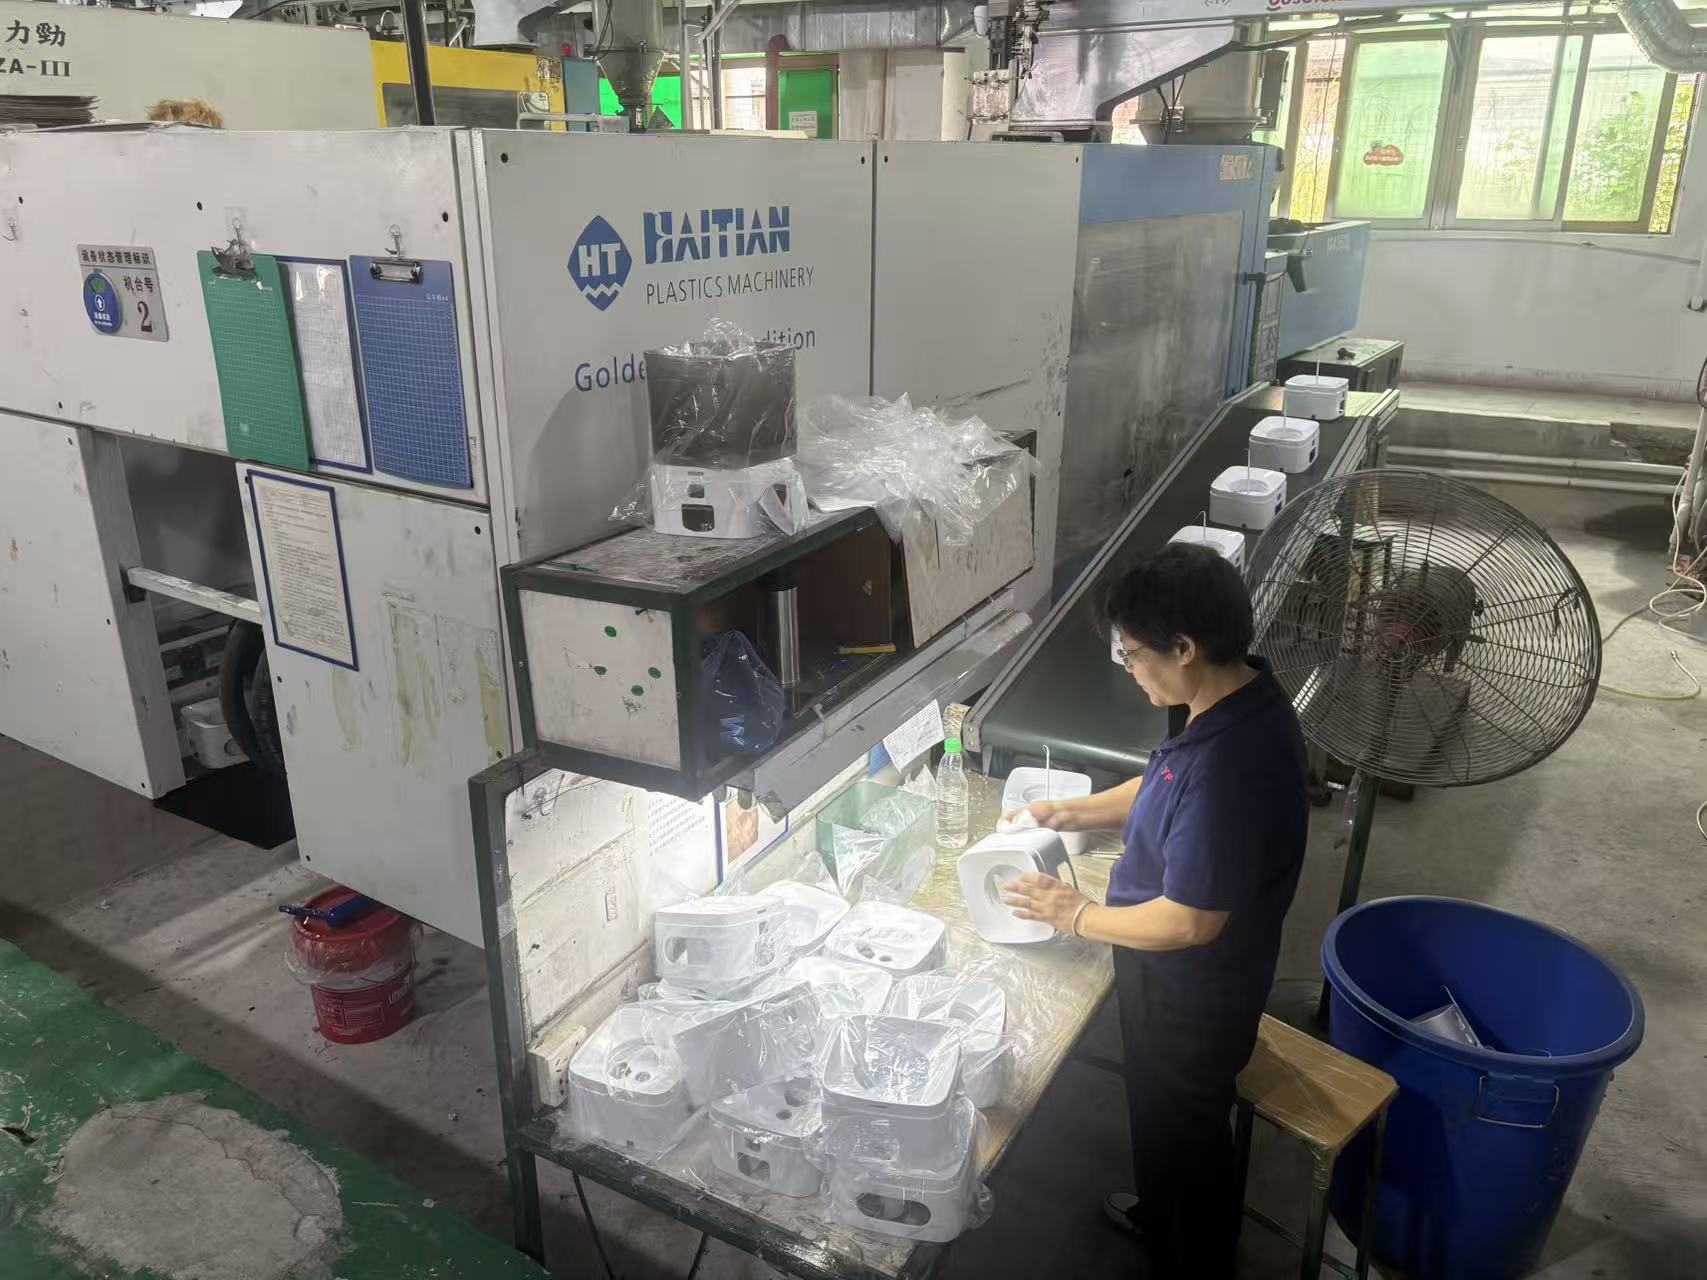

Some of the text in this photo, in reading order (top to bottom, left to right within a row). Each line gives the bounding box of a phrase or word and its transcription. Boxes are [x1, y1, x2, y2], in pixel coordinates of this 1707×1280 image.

[5, 19, 66, 47] 力勁
[643, 206, 790, 264] HAITIAN
[577, 242, 621, 278] HT
[123, 275, 154, 295] 机台号
[646, 265, 815, 305] PLASTICS MACHINERY
[137, 300, 153, 333] 2
[575, 353, 647, 392] Golde
